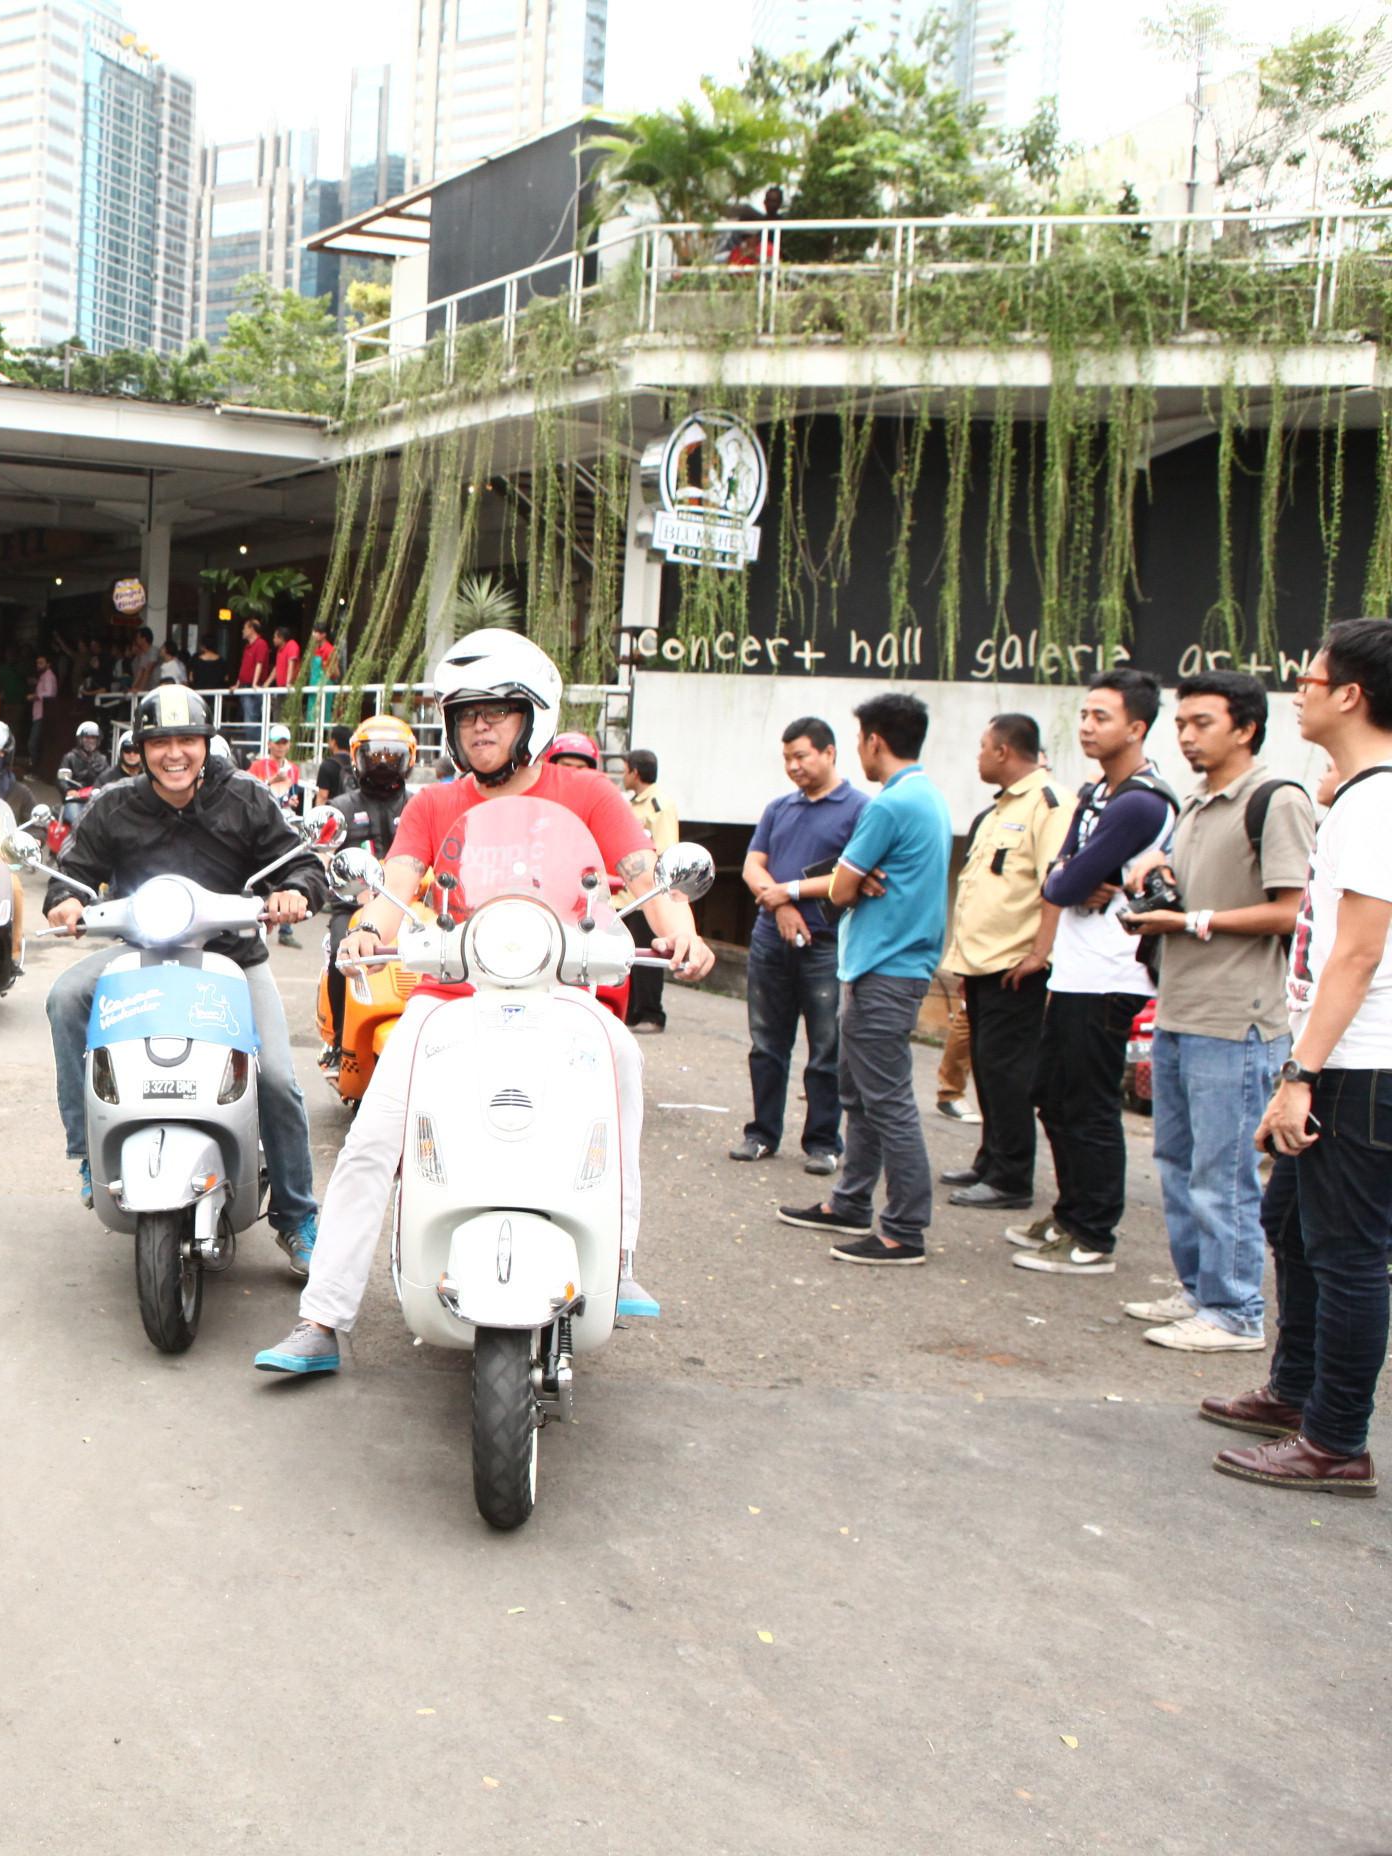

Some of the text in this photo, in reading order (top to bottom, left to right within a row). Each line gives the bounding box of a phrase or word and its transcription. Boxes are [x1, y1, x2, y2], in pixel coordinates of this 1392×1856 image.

[850, 626, 922, 668] hall
[144, 1081, 150, 1093] B
[151, 1081, 175, 1093] 3272
